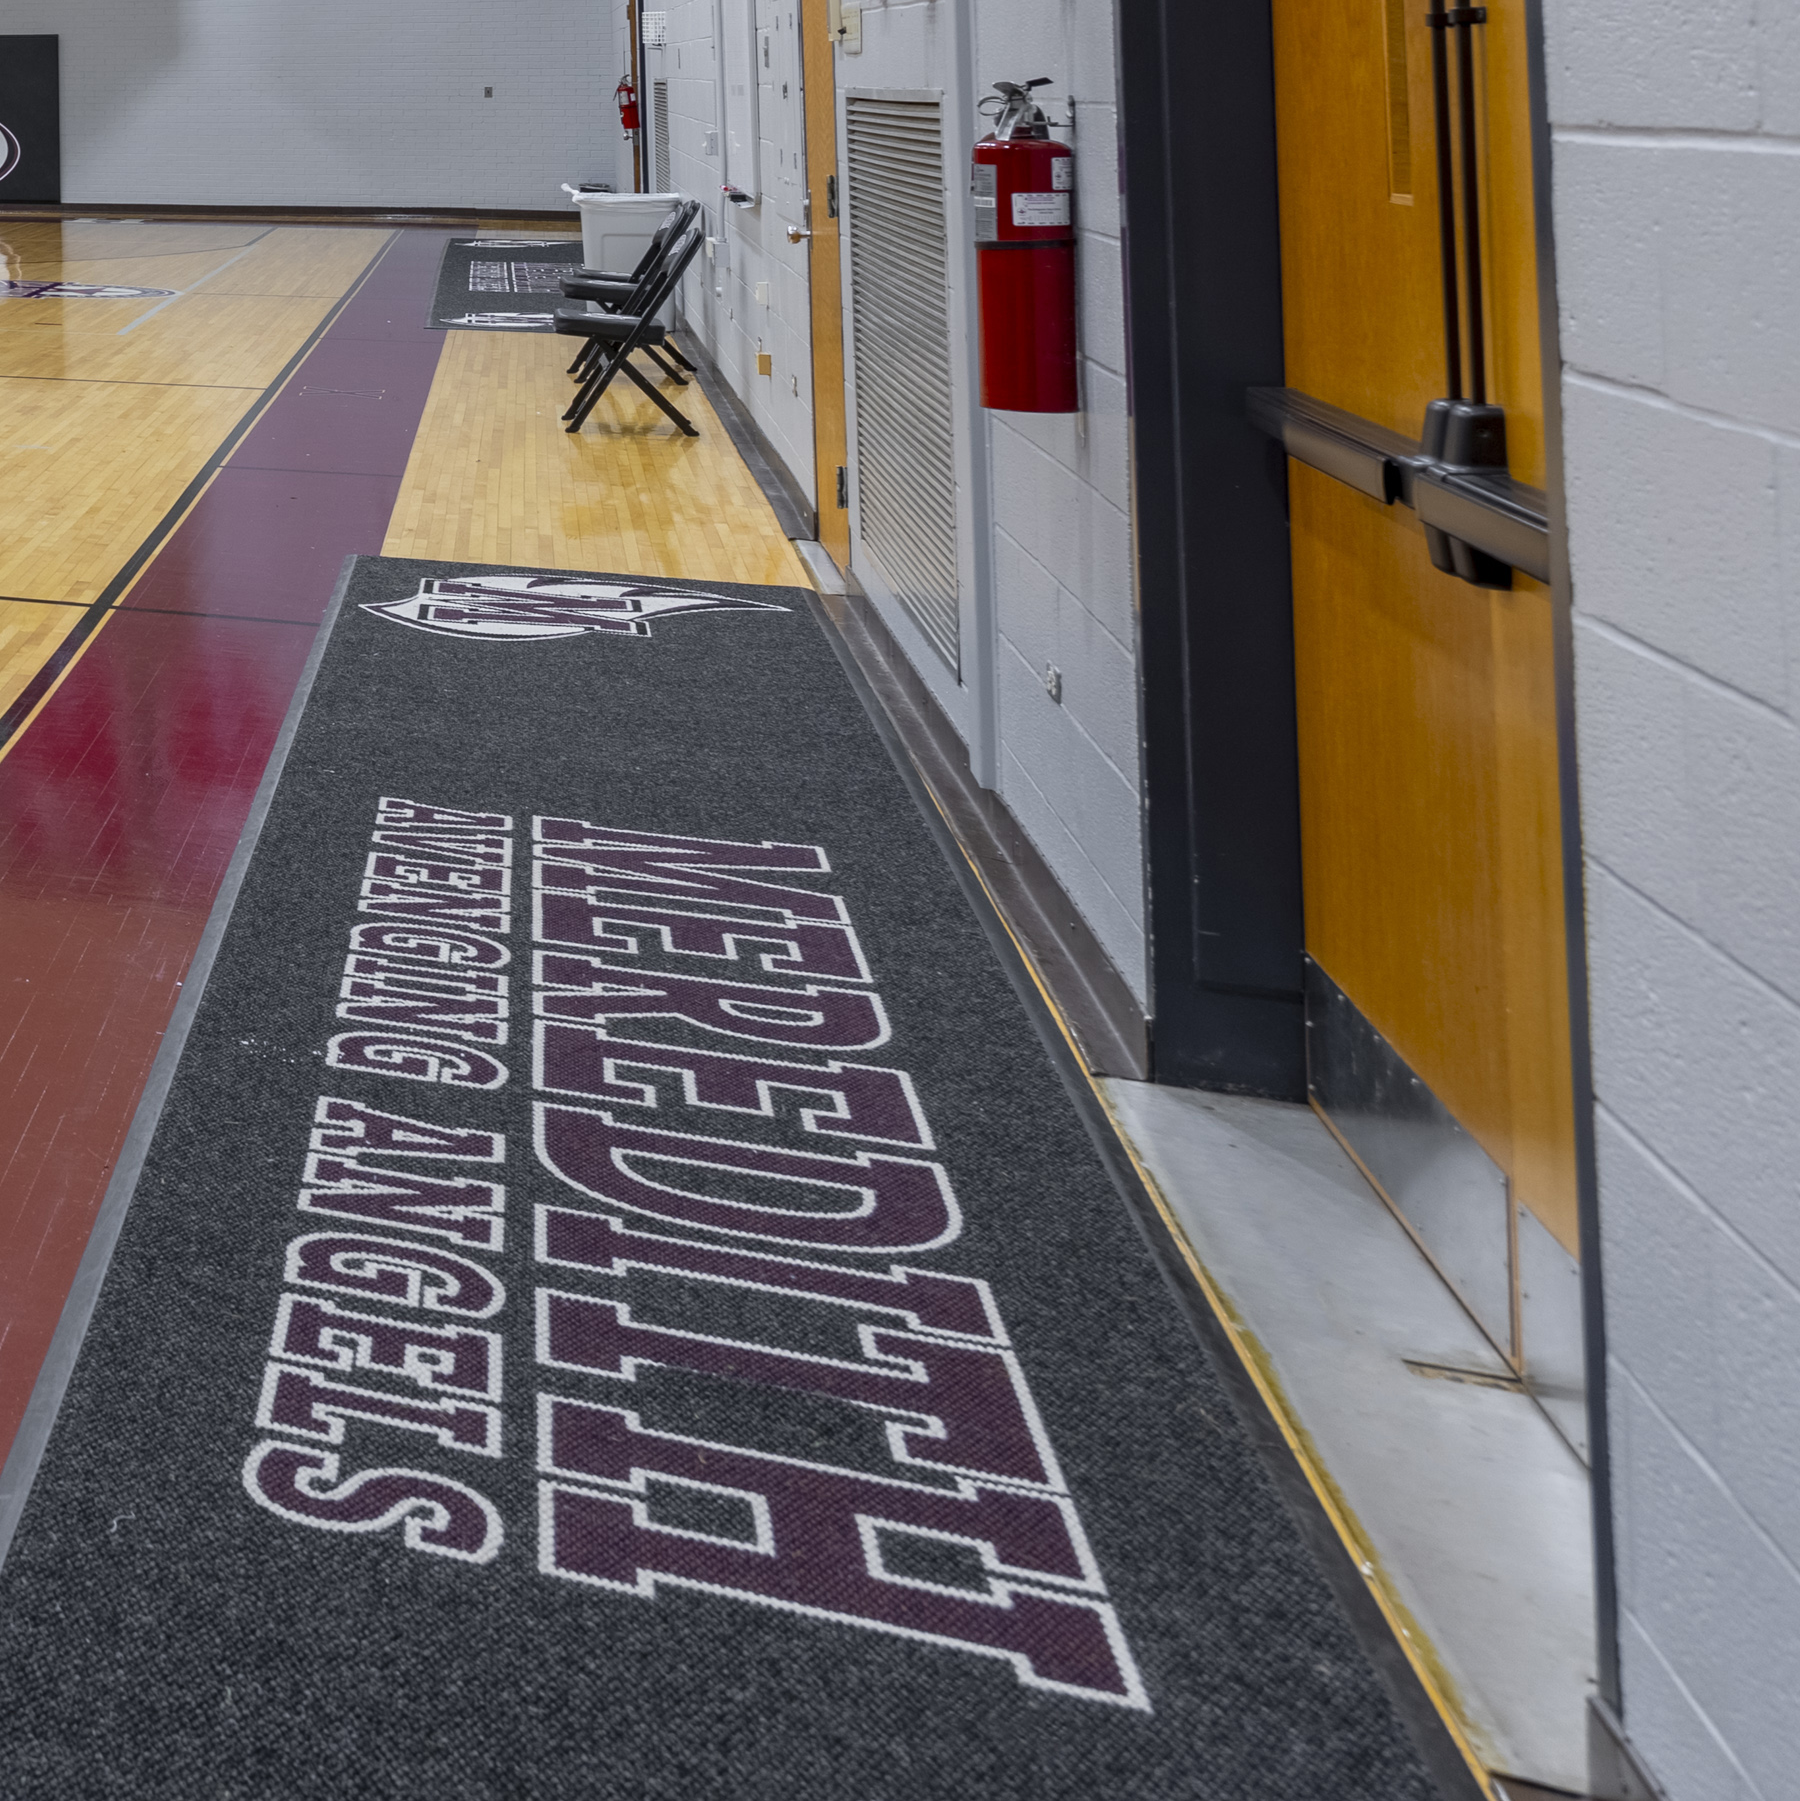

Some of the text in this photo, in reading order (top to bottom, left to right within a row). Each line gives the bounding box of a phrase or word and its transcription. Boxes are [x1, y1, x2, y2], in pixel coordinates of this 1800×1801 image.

[242, 796, 513, 1566] AVENGING ANGELS
[531, 811, 1155, 1716] MEREDITH
